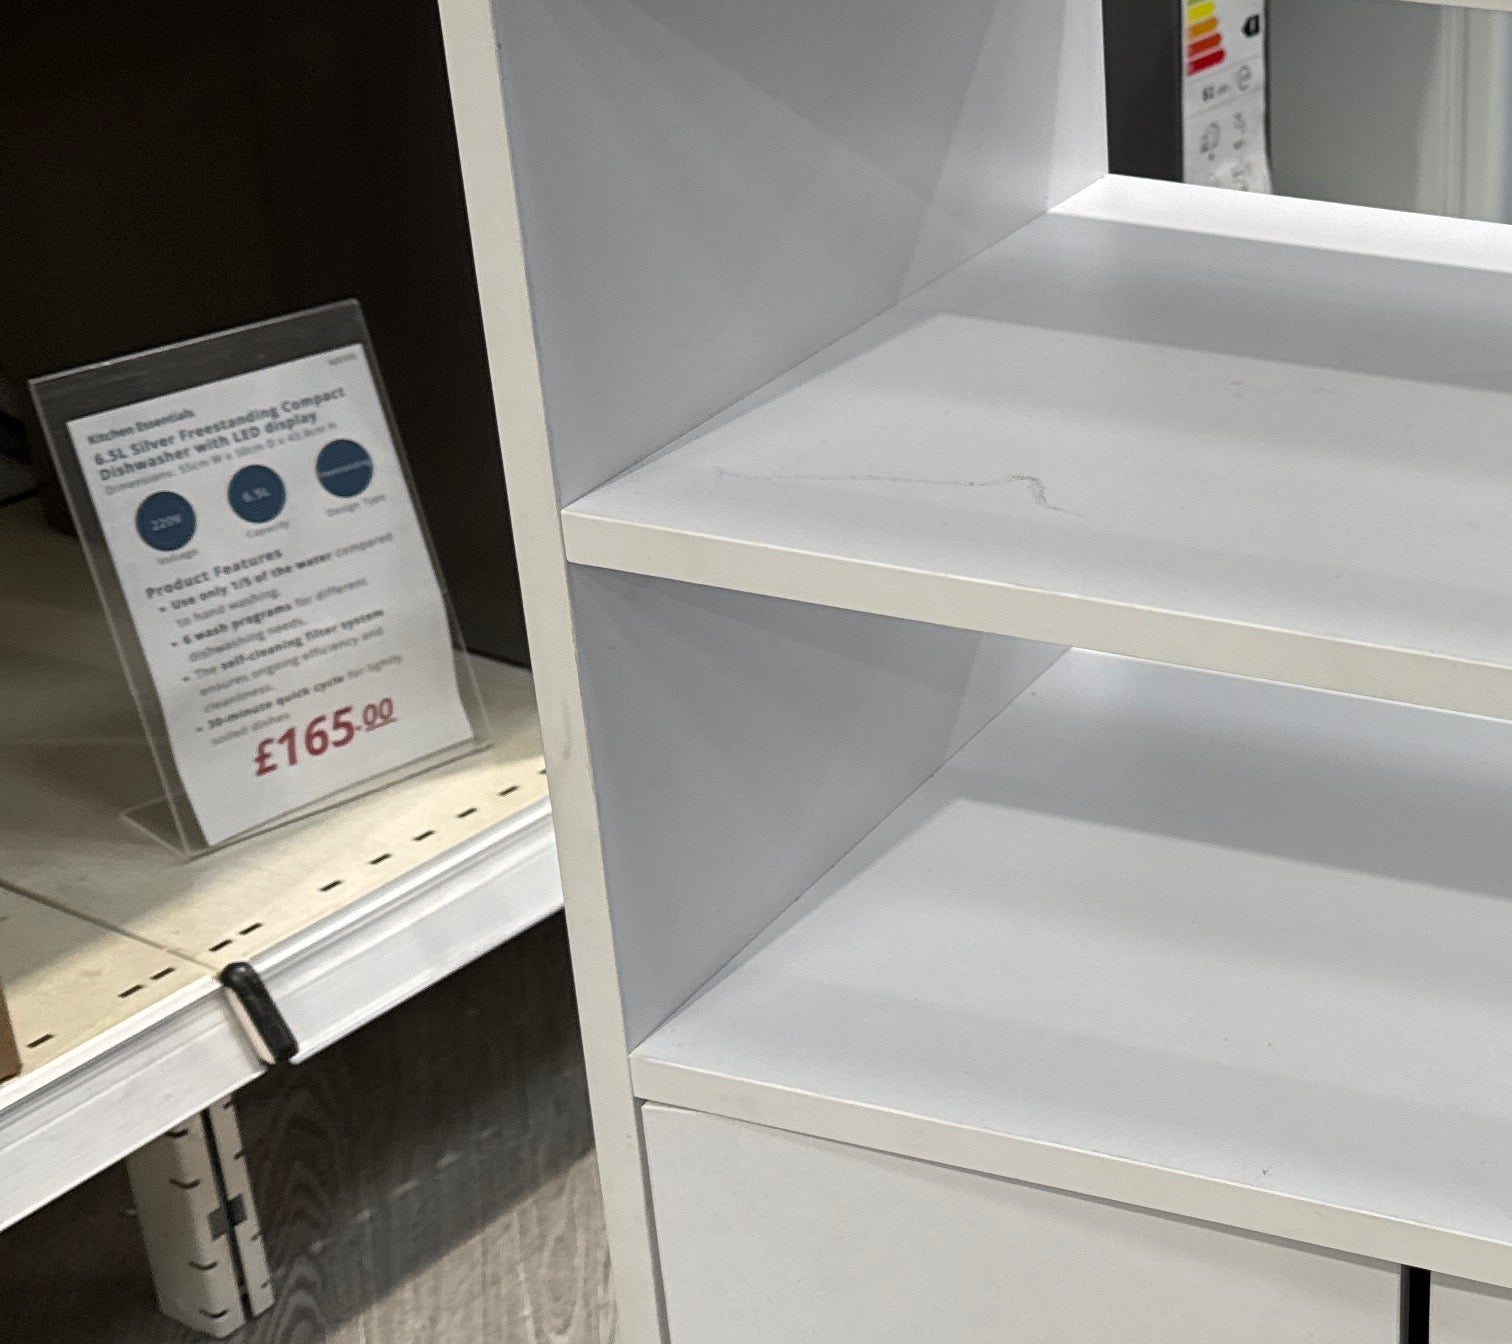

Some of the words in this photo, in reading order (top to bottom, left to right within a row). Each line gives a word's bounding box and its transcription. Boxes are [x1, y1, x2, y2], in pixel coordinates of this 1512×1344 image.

[93, 448, 128, 465] 6.5L
[129, 436, 175, 455] Silver
[178, 407, 280, 440] Freestanding
[280, 388, 345, 412] Compact
[98, 448, 189, 480] Dishwasher
[193, 436, 230, 453] with
[231, 426, 261, 443] LED
[264, 412, 317, 433] display
[145, 572, 210, 598] Product
[212, 550, 282, 577] Features
[253, 698, 398, 776] £165.00
